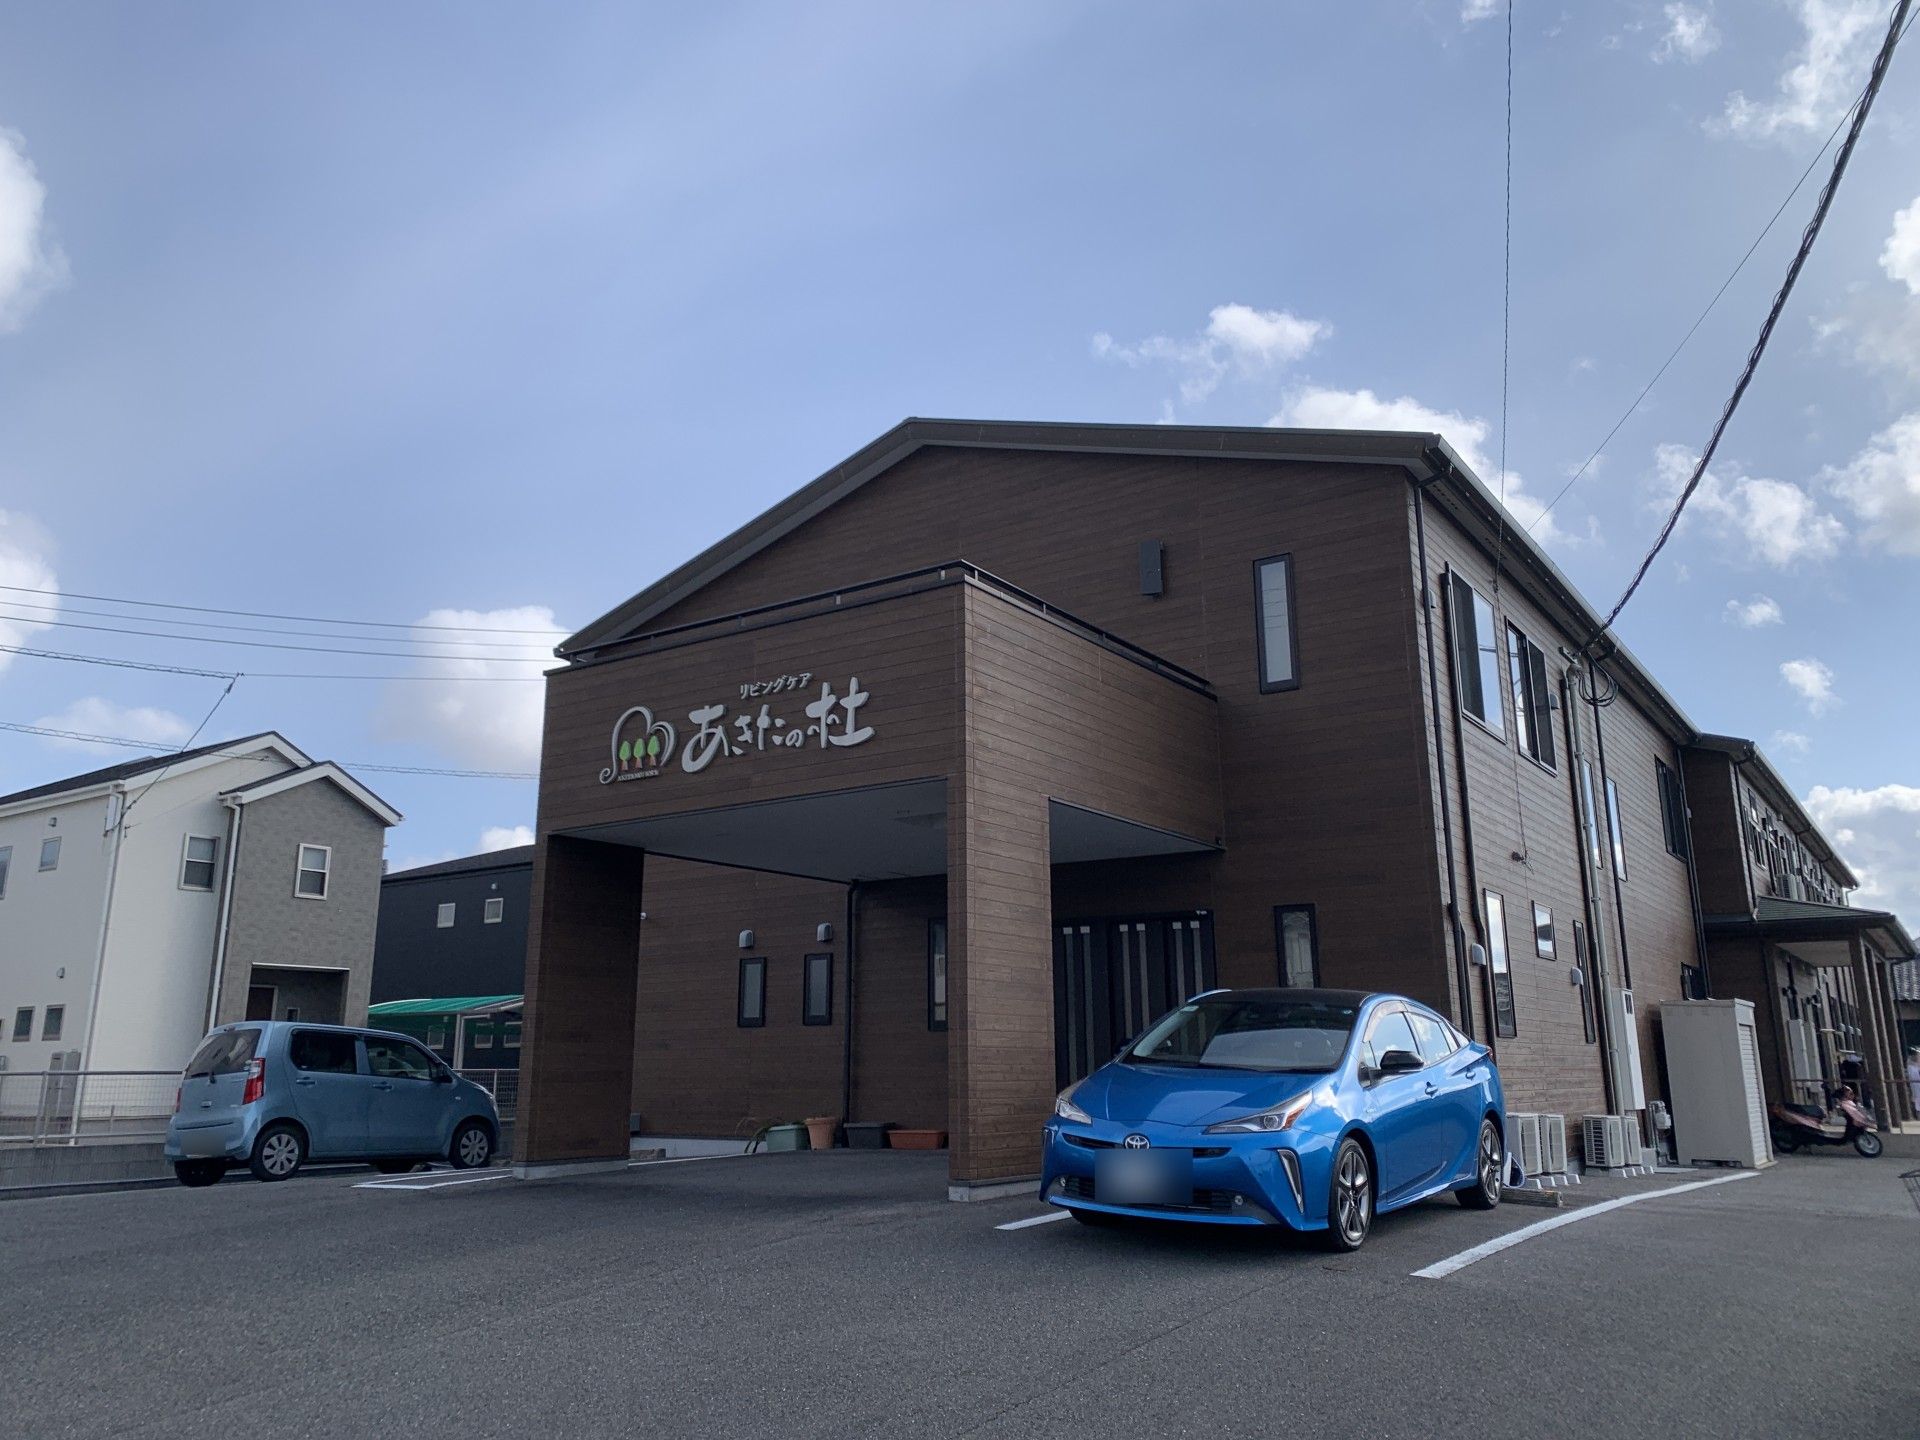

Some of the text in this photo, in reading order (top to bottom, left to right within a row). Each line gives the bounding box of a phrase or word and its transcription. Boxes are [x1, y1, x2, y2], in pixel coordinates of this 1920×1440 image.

[740, 673, 812, 699] リビングケア
[682, 677, 876, 773] あきたの杜
